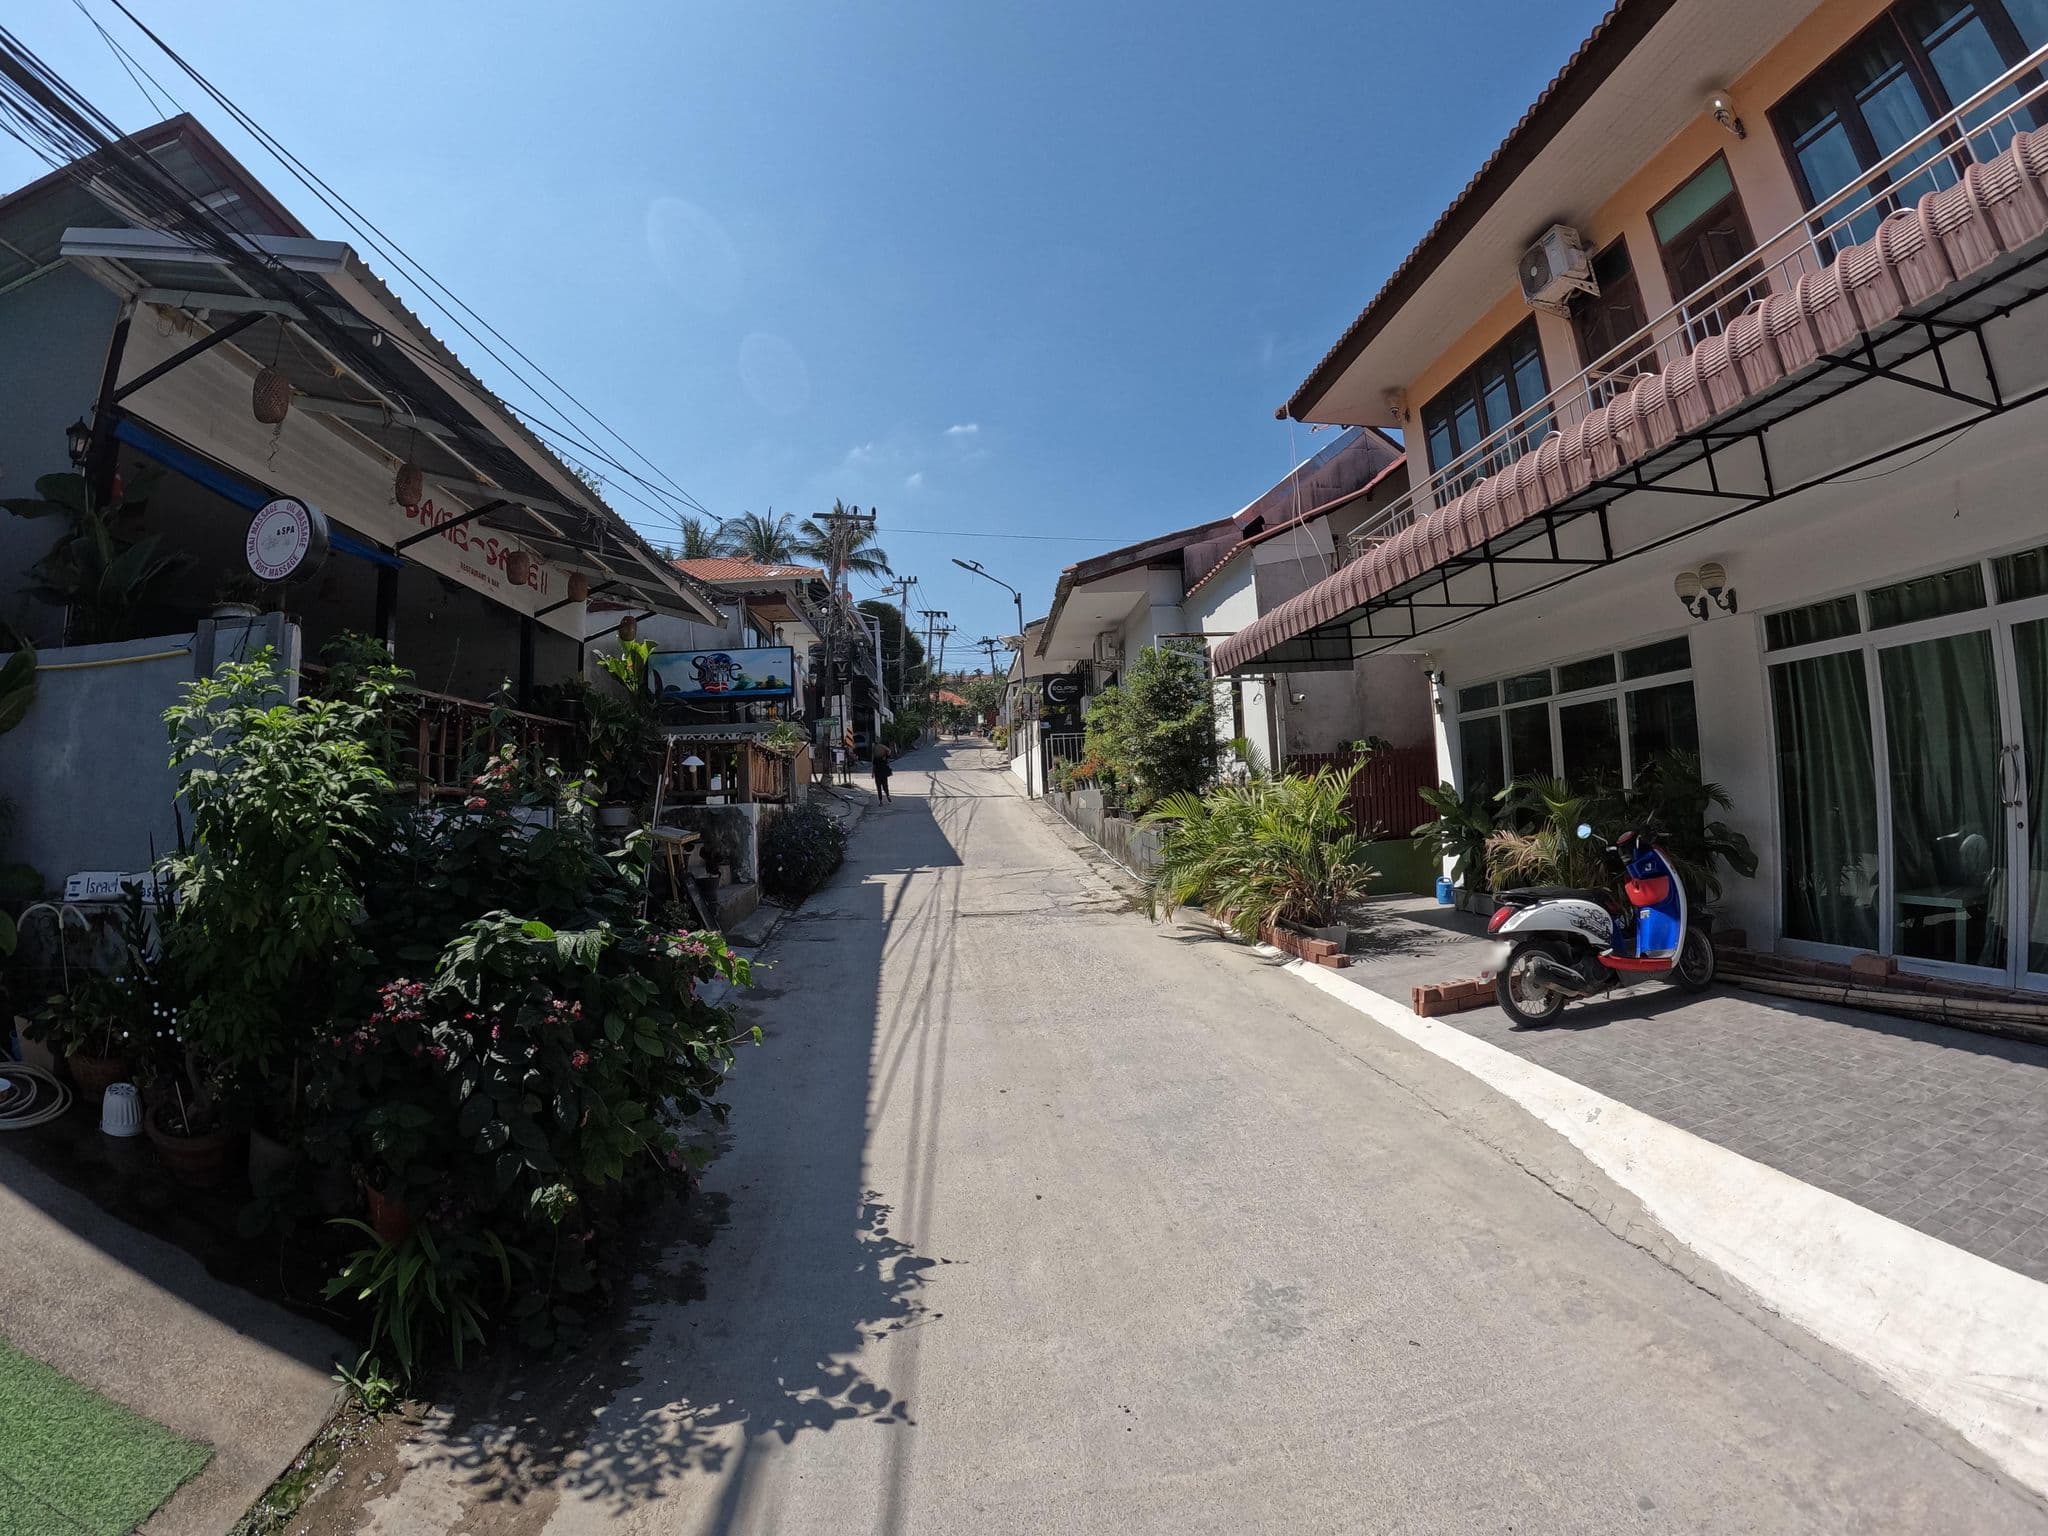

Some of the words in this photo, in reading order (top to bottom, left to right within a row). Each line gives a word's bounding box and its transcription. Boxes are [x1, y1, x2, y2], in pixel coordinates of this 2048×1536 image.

[248, 536, 256, 556] THAI
[252, 503, 278, 535] MASSAGE
[281, 526, 295, 535] SPA
[286, 502, 296, 513] OIL
[296, 509, 309, 548] MASSAGE
[254, 560, 269, 574] FOOT
[268, 554, 299, 577] MASSAGE
